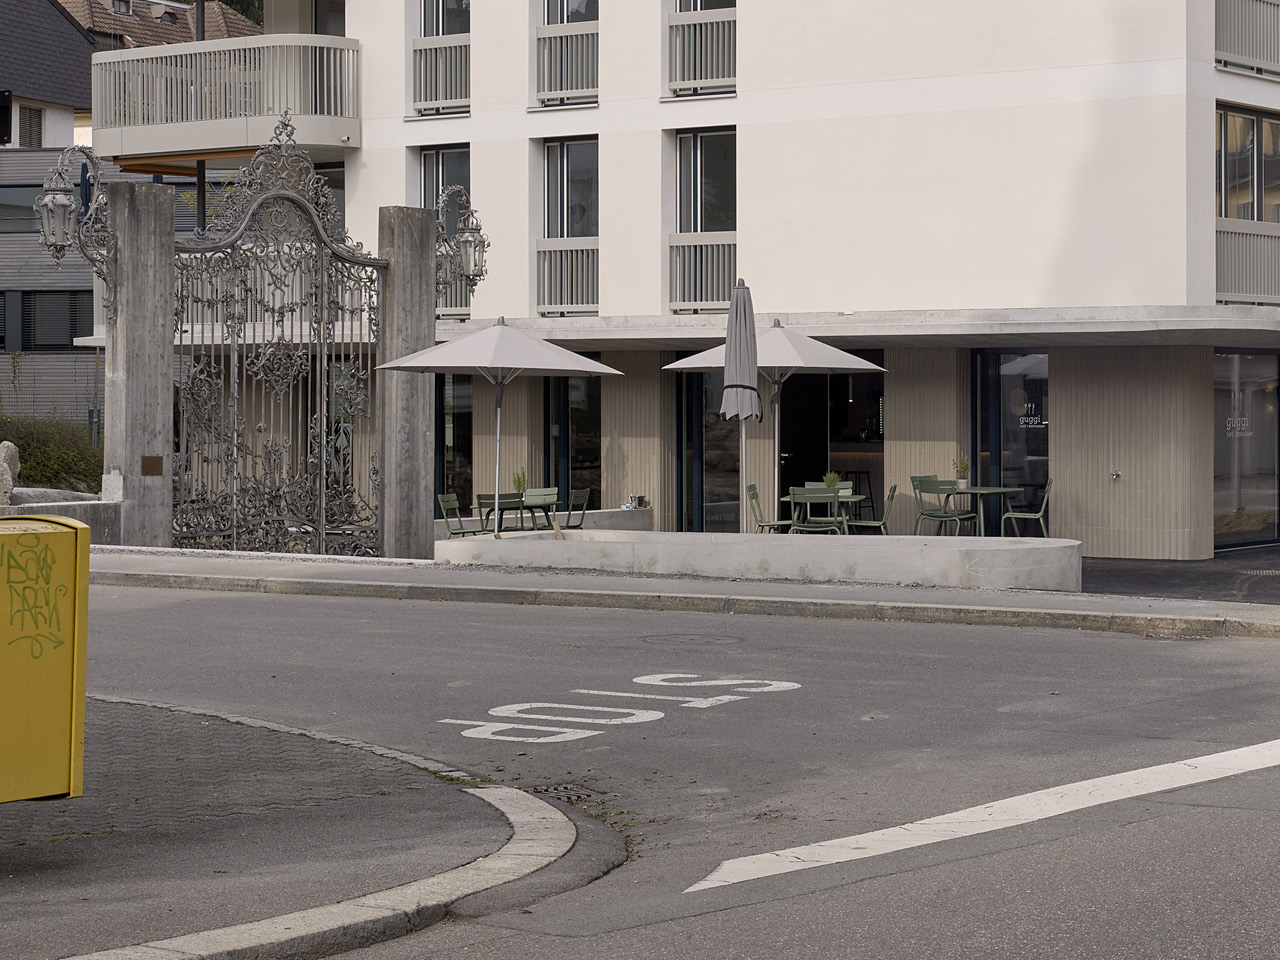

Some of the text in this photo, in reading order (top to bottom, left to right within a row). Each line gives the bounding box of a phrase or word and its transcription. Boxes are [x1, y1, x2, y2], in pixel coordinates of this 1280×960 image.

[1019, 414, 1041, 424] guggi
[1226, 413, 1249, 431] guggi
[436, 673, 802, 743] STOP
